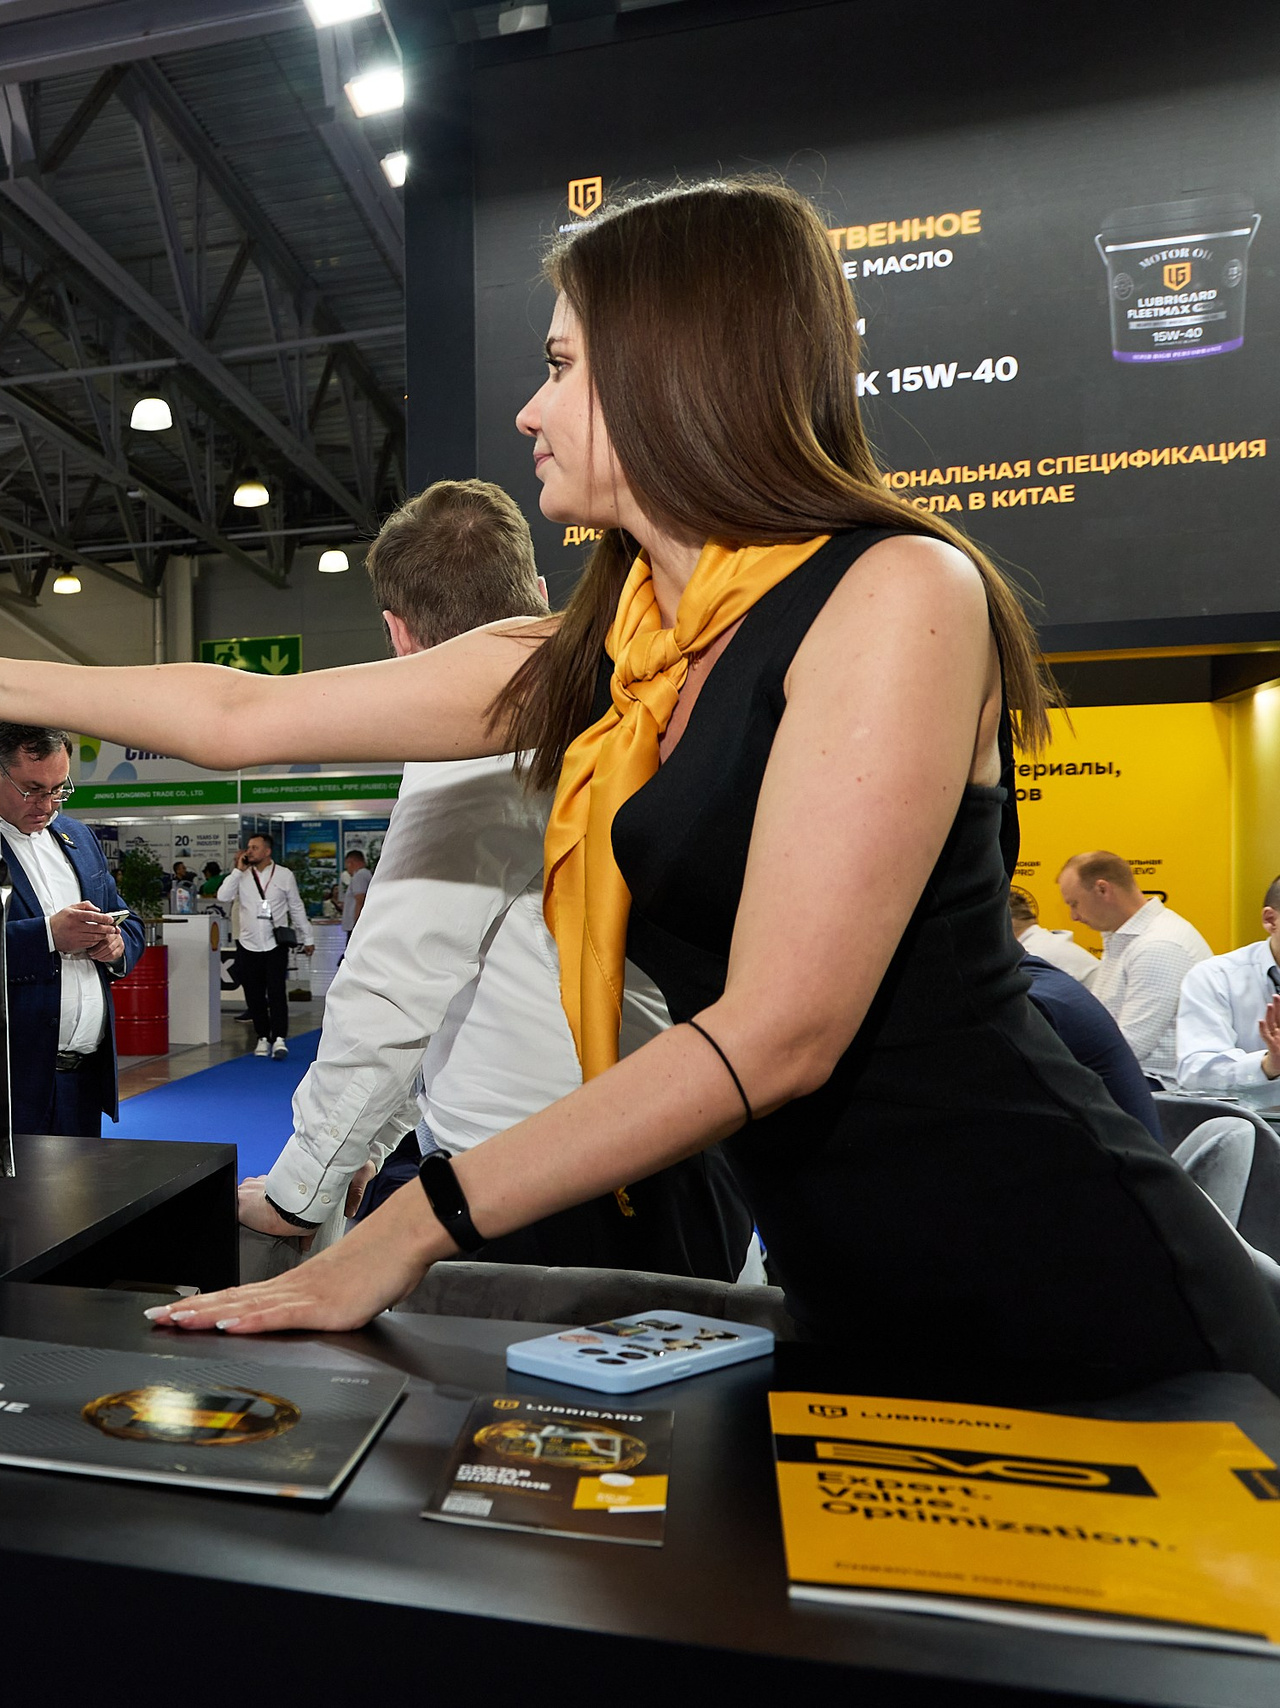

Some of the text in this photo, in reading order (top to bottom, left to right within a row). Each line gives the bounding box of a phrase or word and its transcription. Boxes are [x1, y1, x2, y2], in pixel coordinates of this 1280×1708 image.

[827, 208, 983, 251] ТВЕННОЕ
[842, 248, 954, 280] Е МАСЛО
[1138, 247, 1190, 269] MOTOR
[1137, 289, 1218, 308] LUBRIGARD
[1126, 304, 1191, 319] FLEETMAX
[1151, 327, 1204, 343] 15W-40
[856, 355, 1019, 397] K 15W-40
[882, 438, 1268, 489] ИОНАЛЬНАЯ СПЕЦИФИКАЦИЯ
[903, 484, 1075, 514] АСЛА В КИТАЕ
[152, 790, 175, 798] TRADE
[280, 785, 318, 794] PRECISION
[319, 784, 341, 792] STEEL
[1014, 787, 1042, 802] ов
[525, 1402, 645, 1423] LUBRIGARD
[860, 1411, 1012, 1431] LUBRIGARD
[817, 1471, 993, 1501] Expert.
[818, 1484, 970, 1513] Value.
[822, 1500, 1178, 1553] Optimization.
